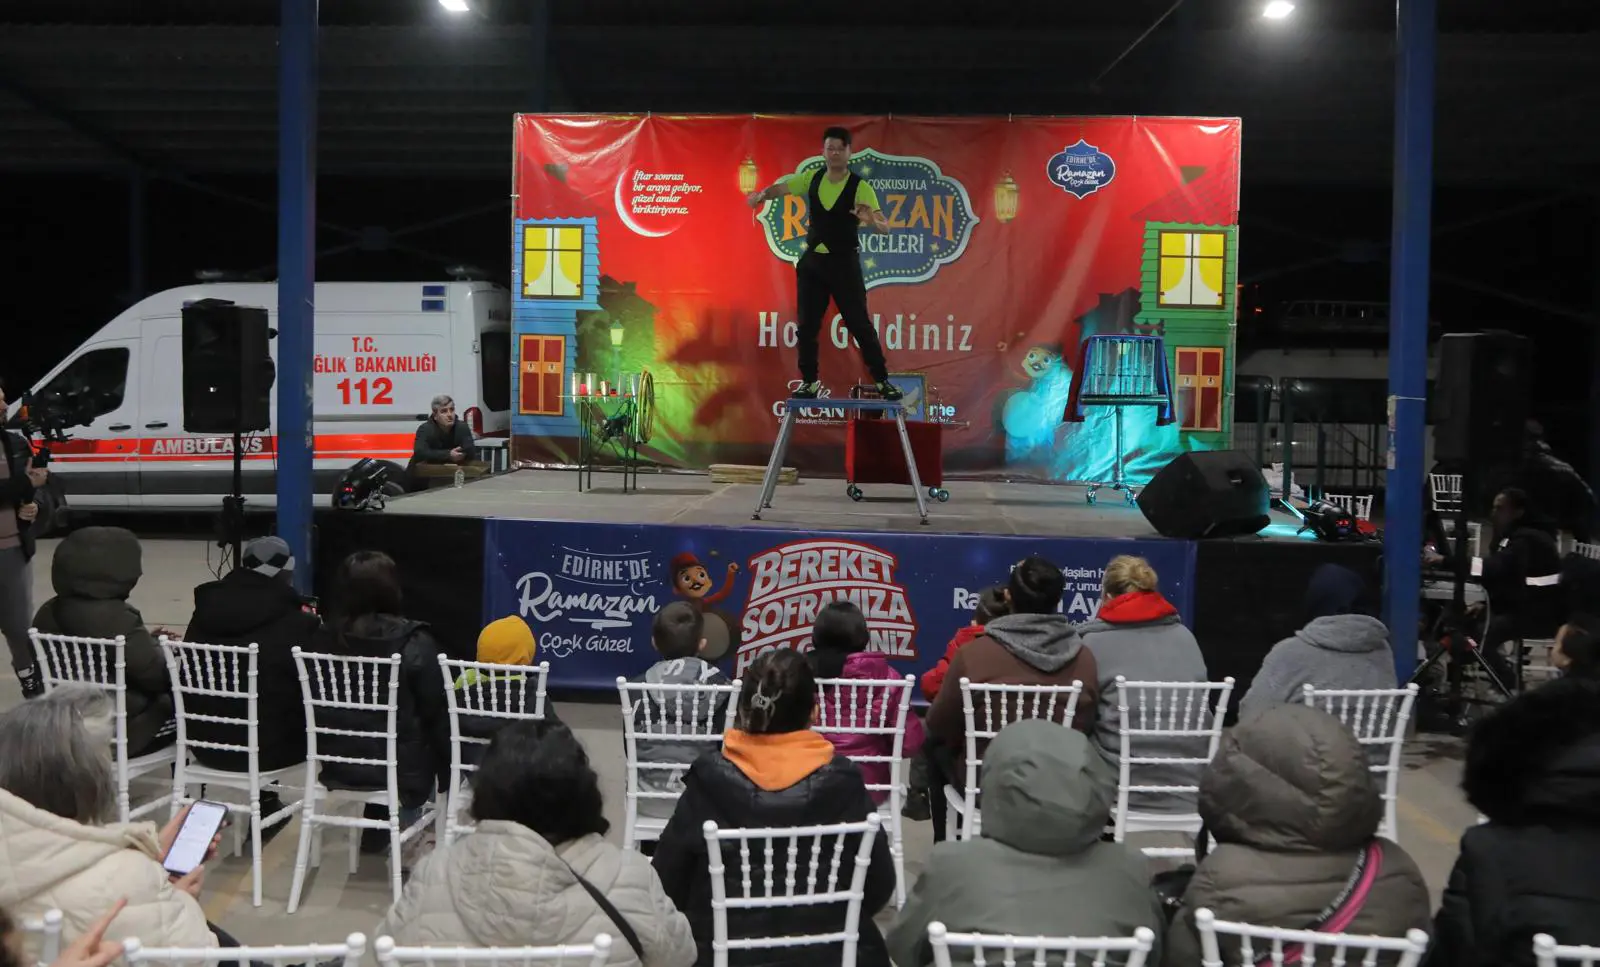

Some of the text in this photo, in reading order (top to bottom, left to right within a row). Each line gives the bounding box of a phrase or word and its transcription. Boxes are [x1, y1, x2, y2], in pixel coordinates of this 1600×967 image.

[654, 173, 684, 181] sonrası
[1056, 164, 1105, 181] Ramazan
[633, 183, 702, 194] bir araya geliyor,
[632, 194, 681, 205] güzel anılar
[633, 205, 688, 216] biriktiriyoruz.
[758, 311, 973, 351] Ho Gldiniz
[352, 337, 378, 352] T.C.
[314, 353, 436, 373] ĞLIK BAKANLIĞI
[337, 377, 393, 405] 112
[561, 554, 651, 580] EDİRNE'DE
[750, 549, 894, 601] BEREKET
[515, 571, 661, 622] Ramazan
